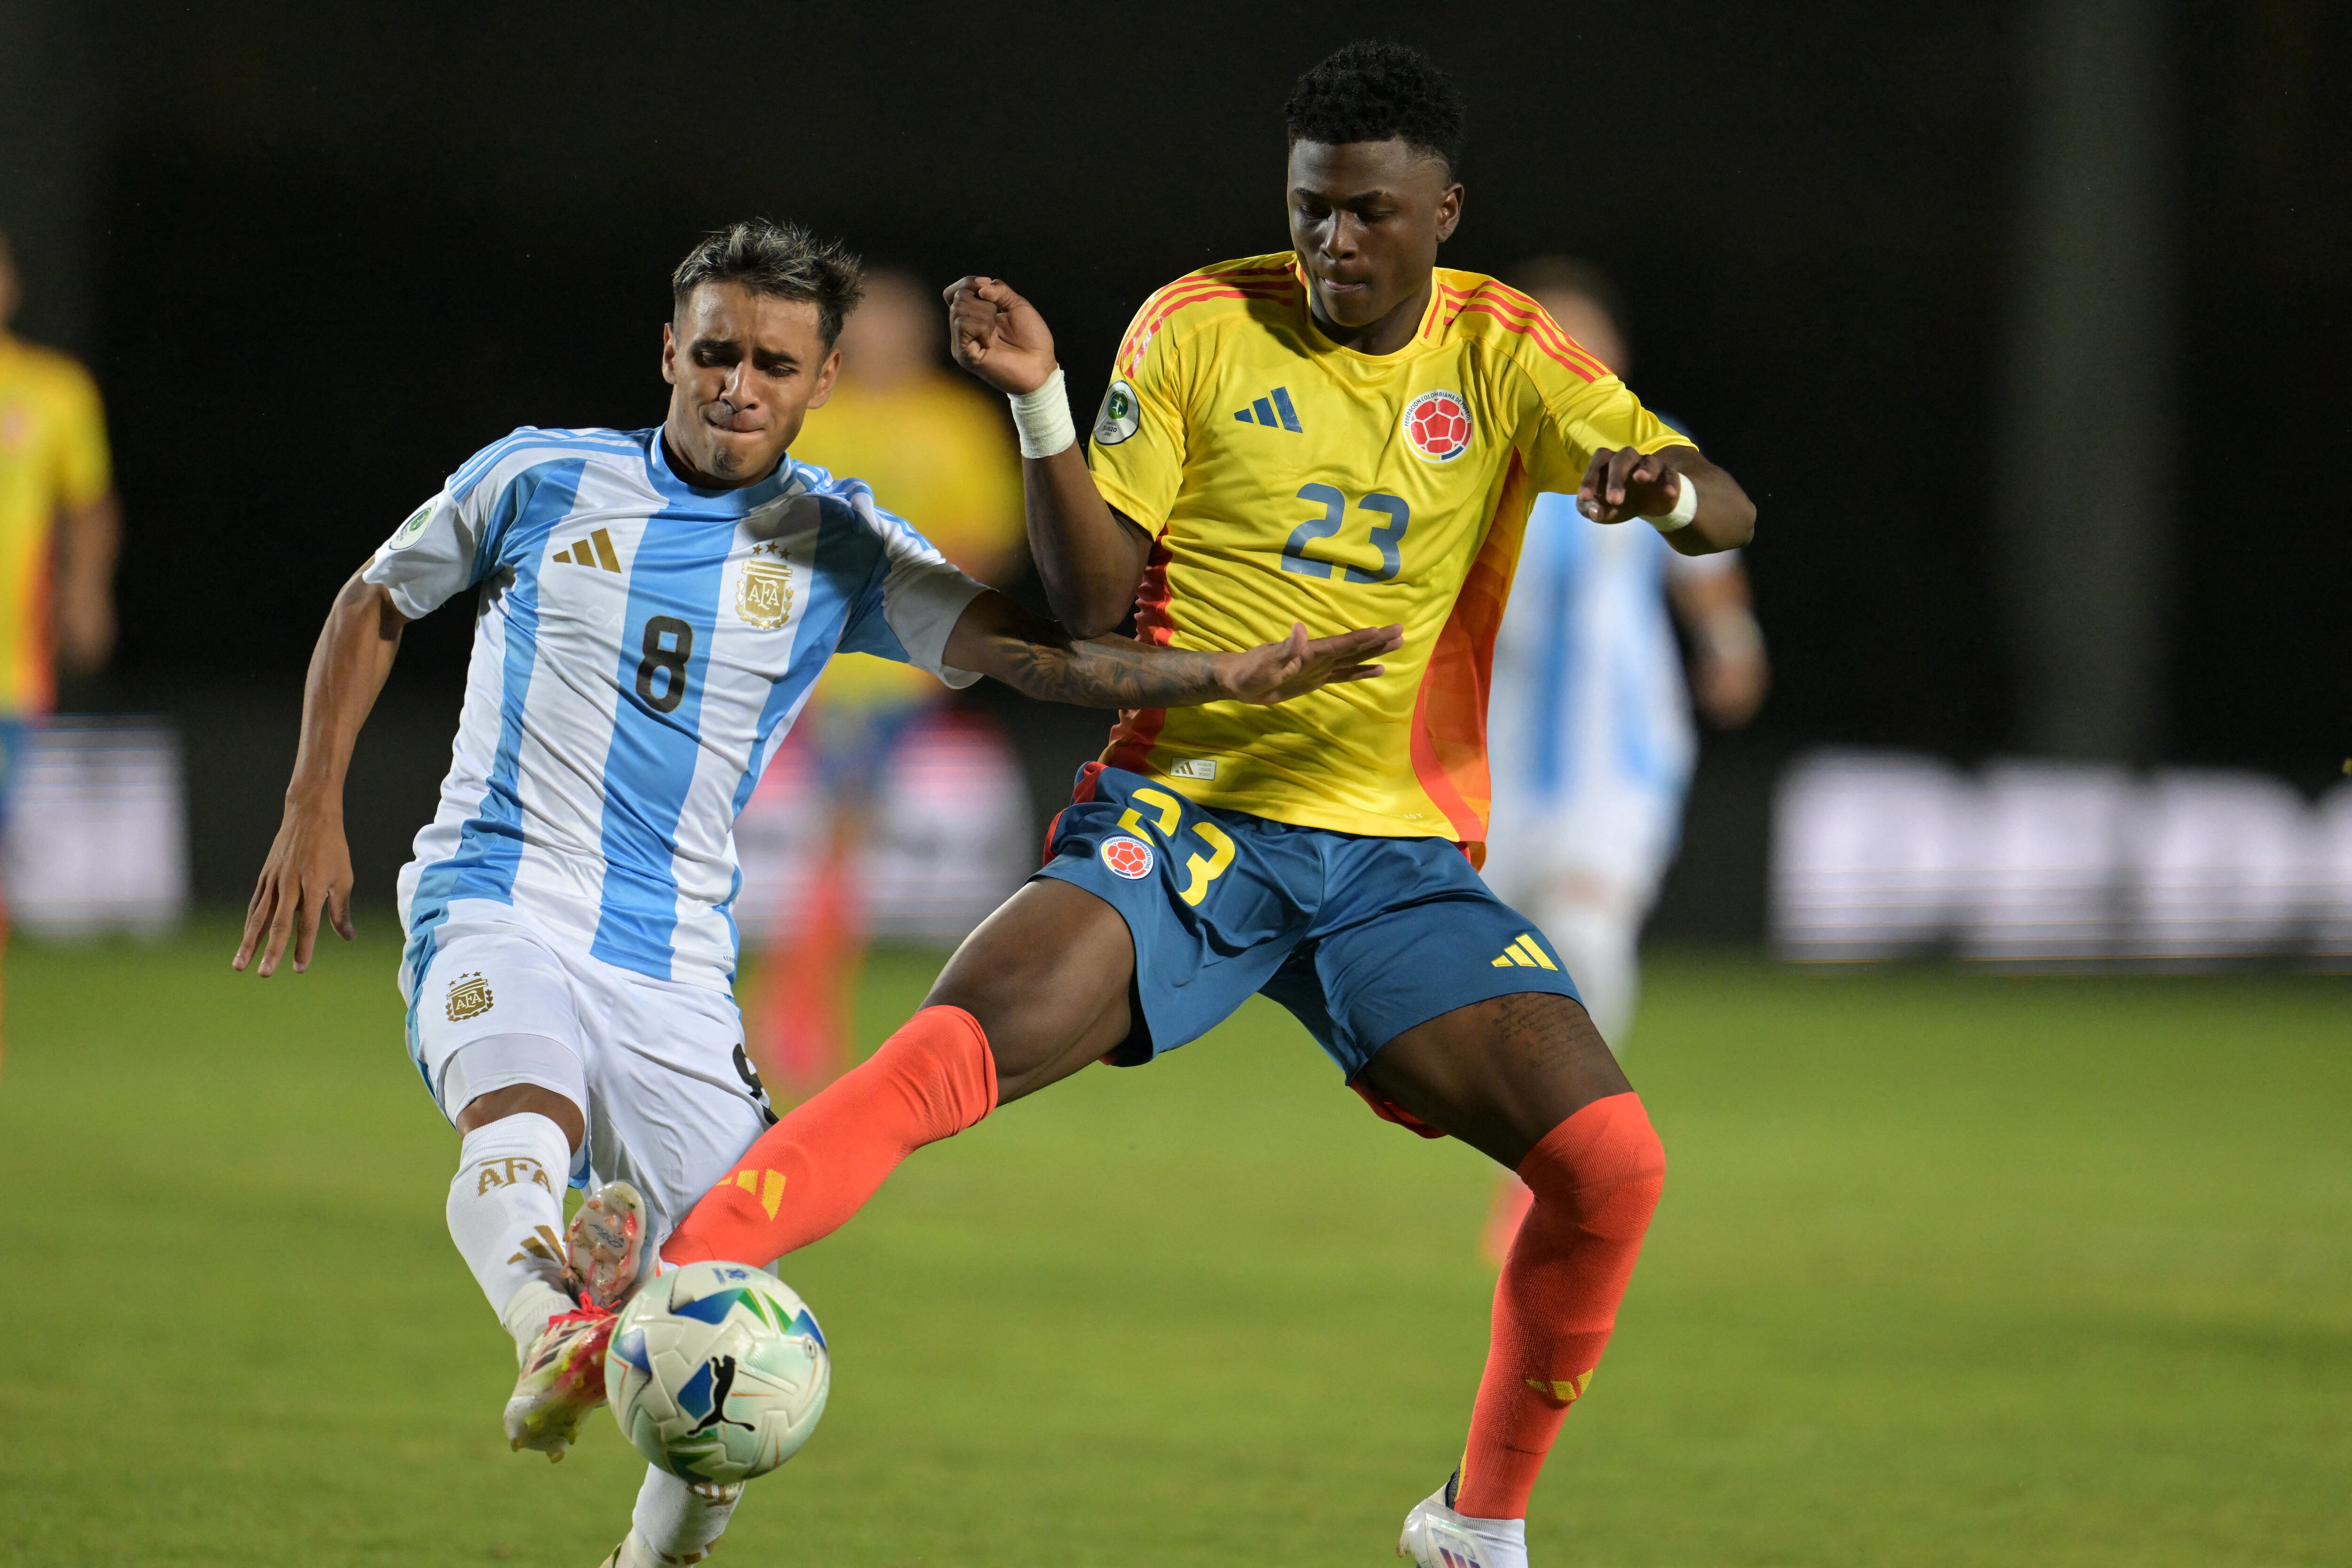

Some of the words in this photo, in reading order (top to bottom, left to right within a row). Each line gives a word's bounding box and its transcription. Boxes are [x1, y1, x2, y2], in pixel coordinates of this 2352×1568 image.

[1421, 392, 1455, 401] COLOMBIANA
[1281, 483, 1410, 584] 23
[747, 577, 780, 610] AFA
[636, 615, 694, 714] 8
[1117, 788, 1236, 906] 23
[455, 990, 483, 1010] AFA
[478, 1157, 552, 1196] AFA
